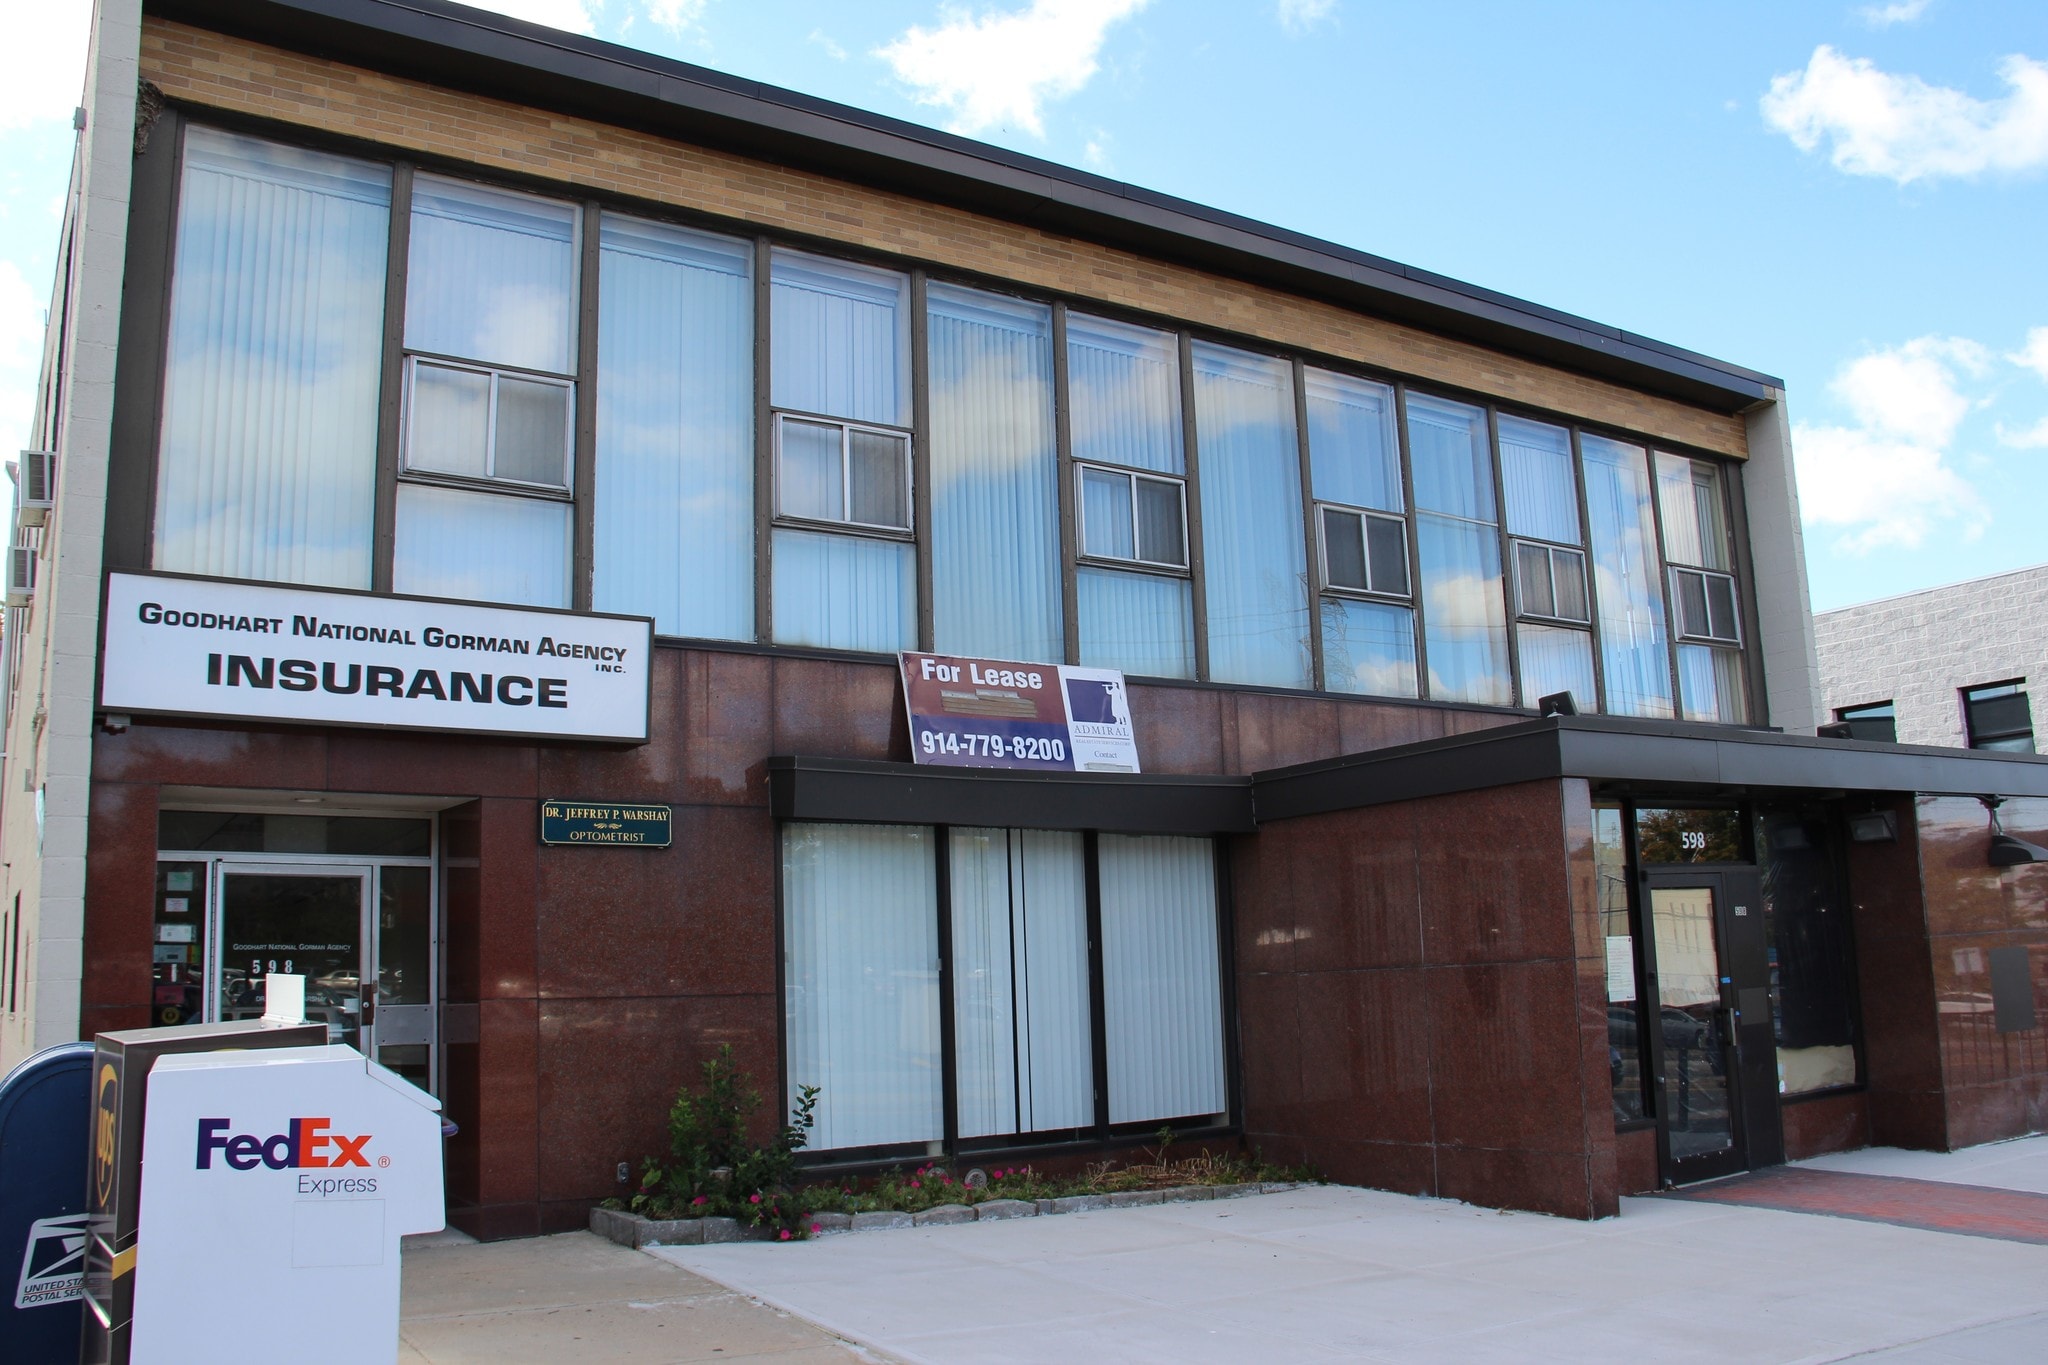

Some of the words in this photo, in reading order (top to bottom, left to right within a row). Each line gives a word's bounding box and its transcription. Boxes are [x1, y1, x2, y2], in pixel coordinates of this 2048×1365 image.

[138, 602, 283, 634] GOODHART
[292, 615, 416, 645] NATIONAL
[423, 627, 529, 655] GORMAN
[536, 637, 627, 662] AGENCY
[595, 664, 626, 674] INC.
[920, 658, 961, 683] For
[970, 663, 1043, 689] Lease
[207, 653, 568, 708] INSURANCE
[1074, 725, 1129, 737] ADMIRAL
[921, 730, 1066, 762] 914-779-8200
[1094, 750, 1118, 759] Contact
[545, 807, 563, 818] DR.
[565, 808, 610, 821] JEFFREY
[613, 809, 620, 820] P.
[622, 810, 669, 821] WARSHAY
[570, 831, 645, 842] OPTOMETRIST
[1682, 832, 1705, 849] 598
[233, 943, 267, 951] GOODHART
[268, 943, 297, 951] NATIONAL
[299, 943, 326, 951] GORMAN
[327, 943, 351, 951] AGENCY
[196, 1118, 373, 1170] FedEx
[298, 1175, 377, 1197] Express
[24, 1280, 65, 1293] UNITED
[22, 1291, 61, 1304] POSTAL
